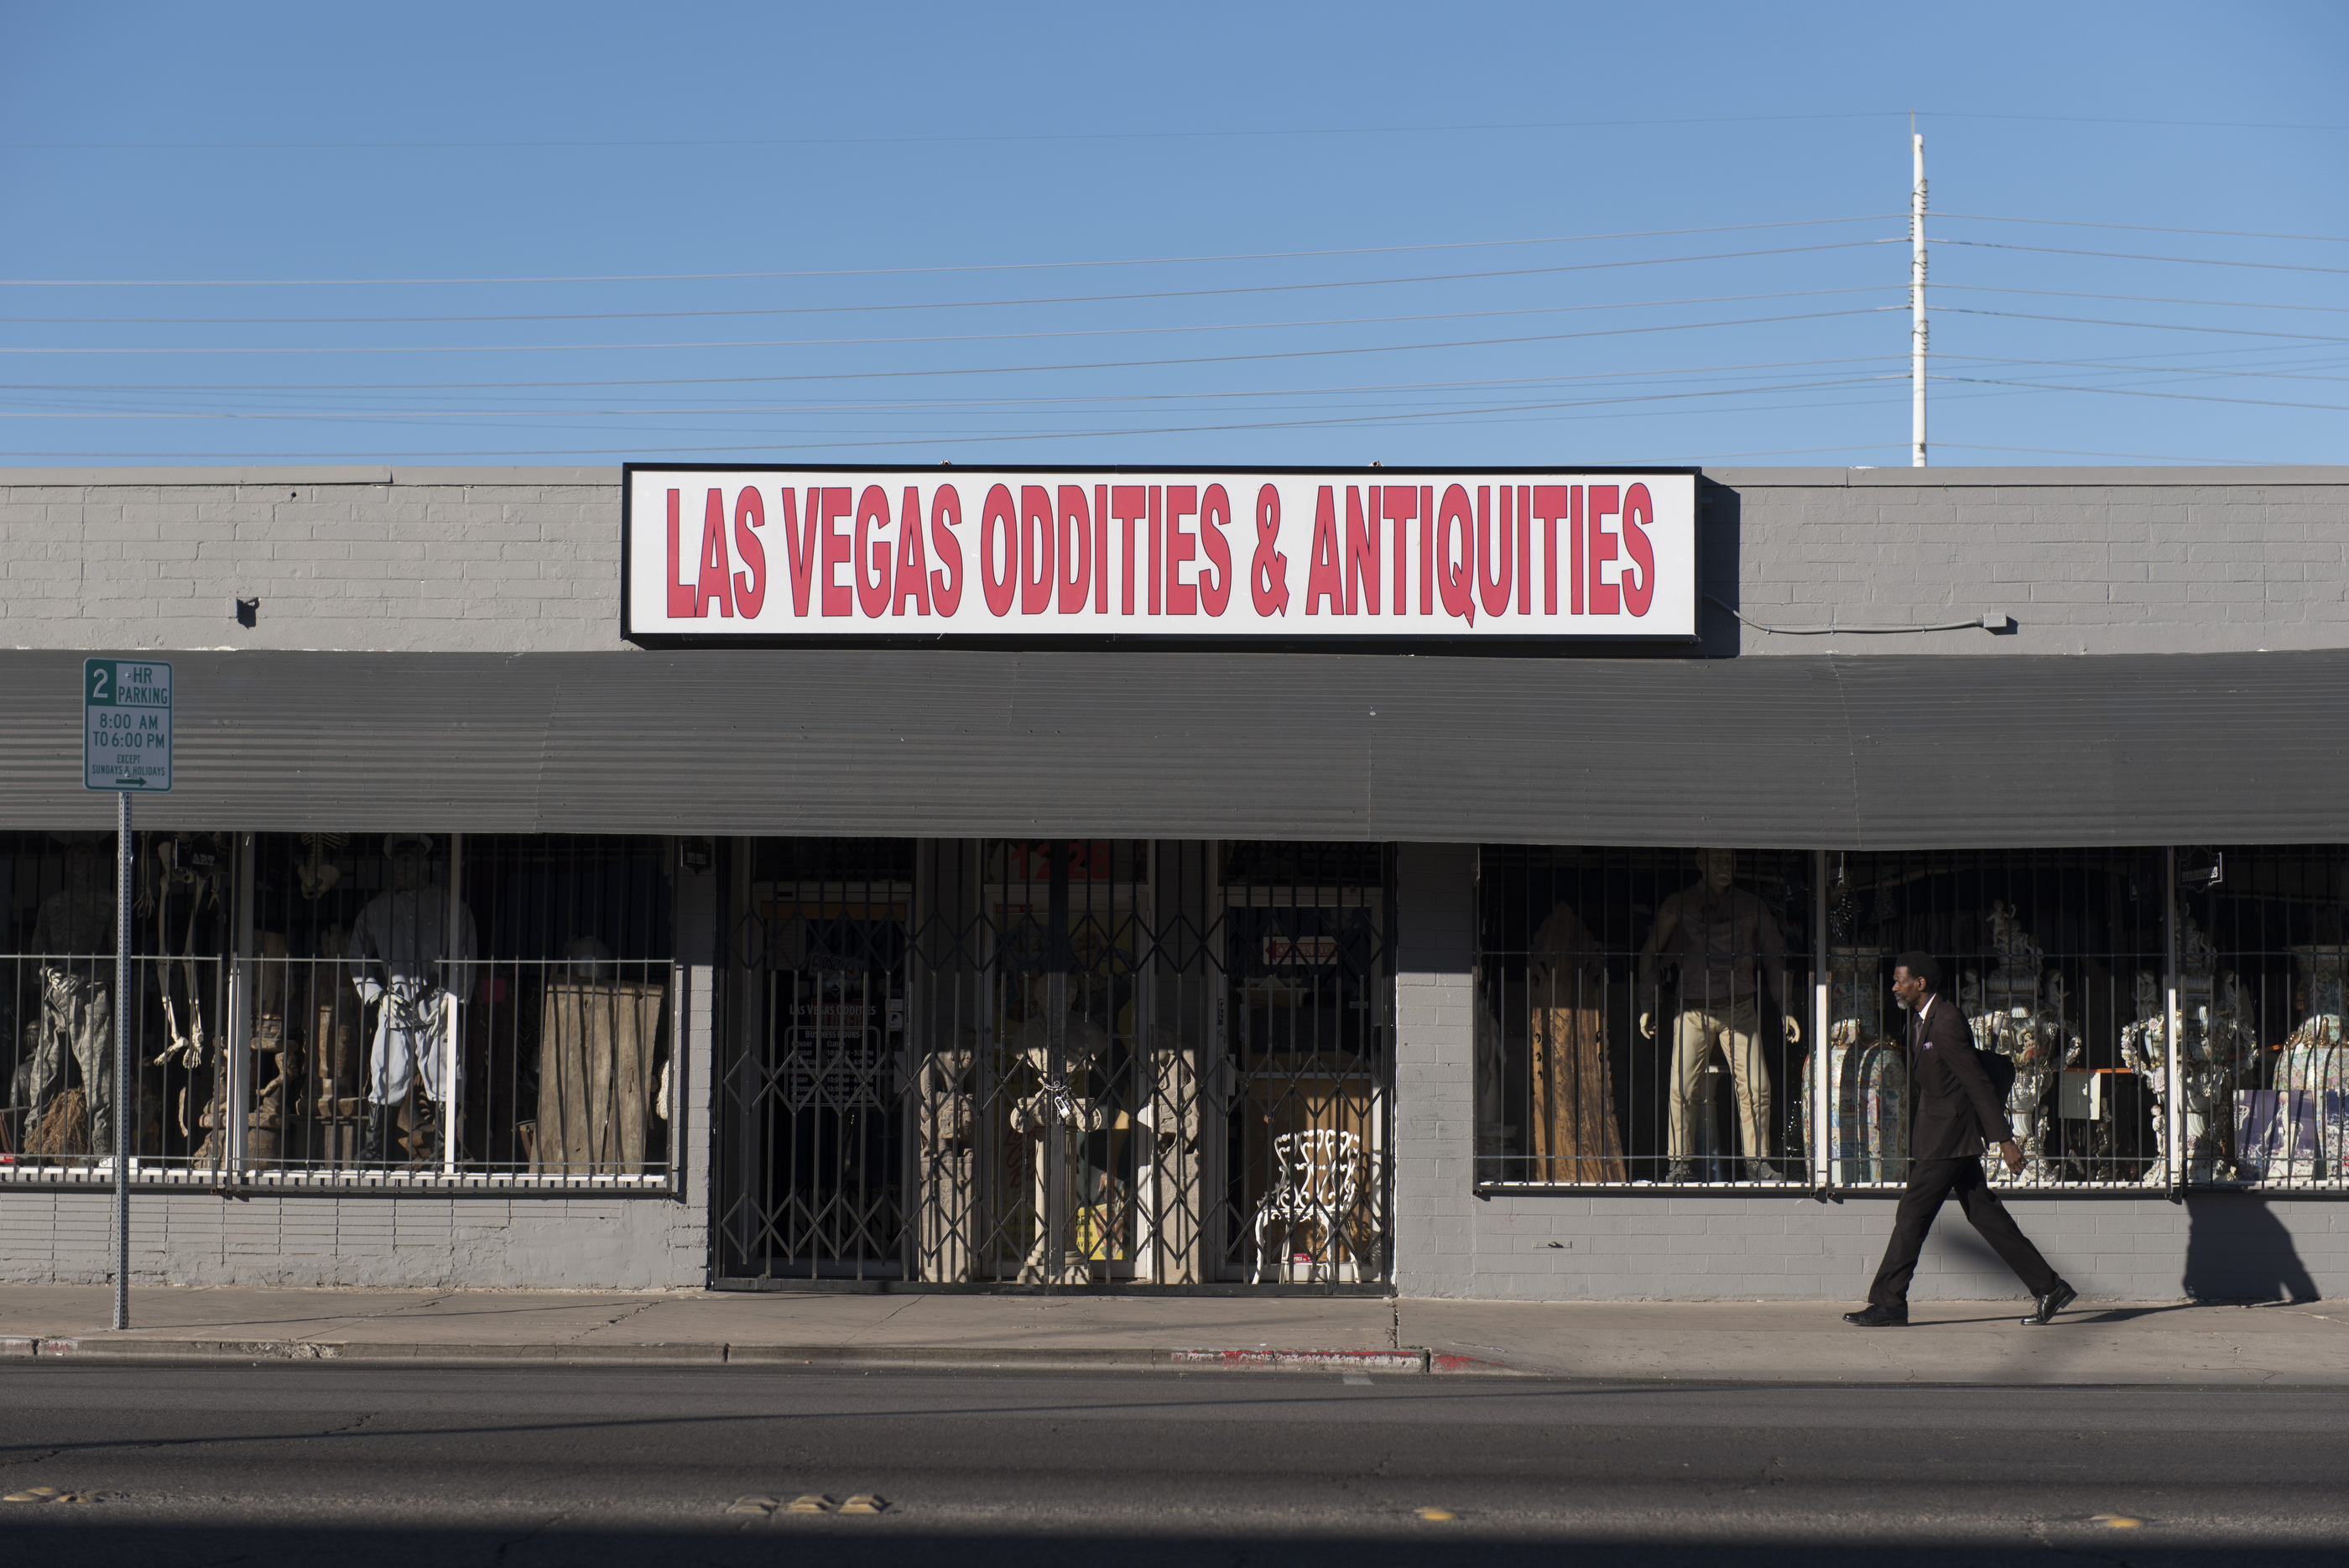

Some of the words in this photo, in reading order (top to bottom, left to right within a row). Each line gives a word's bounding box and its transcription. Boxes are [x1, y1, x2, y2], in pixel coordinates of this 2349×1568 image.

[667, 486, 765, 619] LAS
[782, 484, 962, 618] VEGAS
[981, 483, 1232, 618] ODDITIES
[1251, 483, 1289, 617] &
[1305, 482, 1654, 627] ANTIQUITIES
[92, 668, 109, 699] 2
[133, 667, 153, 684] HR
[117, 685, 168, 705] PARKING
[99, 712, 131, 729] 8:00
[138, 715, 158, 731] AM
[92, 731, 108, 747] TO
[111, 732, 143, 748] 6:00
[147, 733, 164, 748] PM
[117, 753, 141, 764] EXCEPT
[91, 764, 122, 775] SUNDAYS
[133, 766, 165, 776] HOLIDAYS
[191, 852, 215, 866] ART
[1011, 841, 1110, 880] 1228
[836, 1004, 876, 1015] ODDITES
[805, 1029, 836, 1039] BUSNESS
